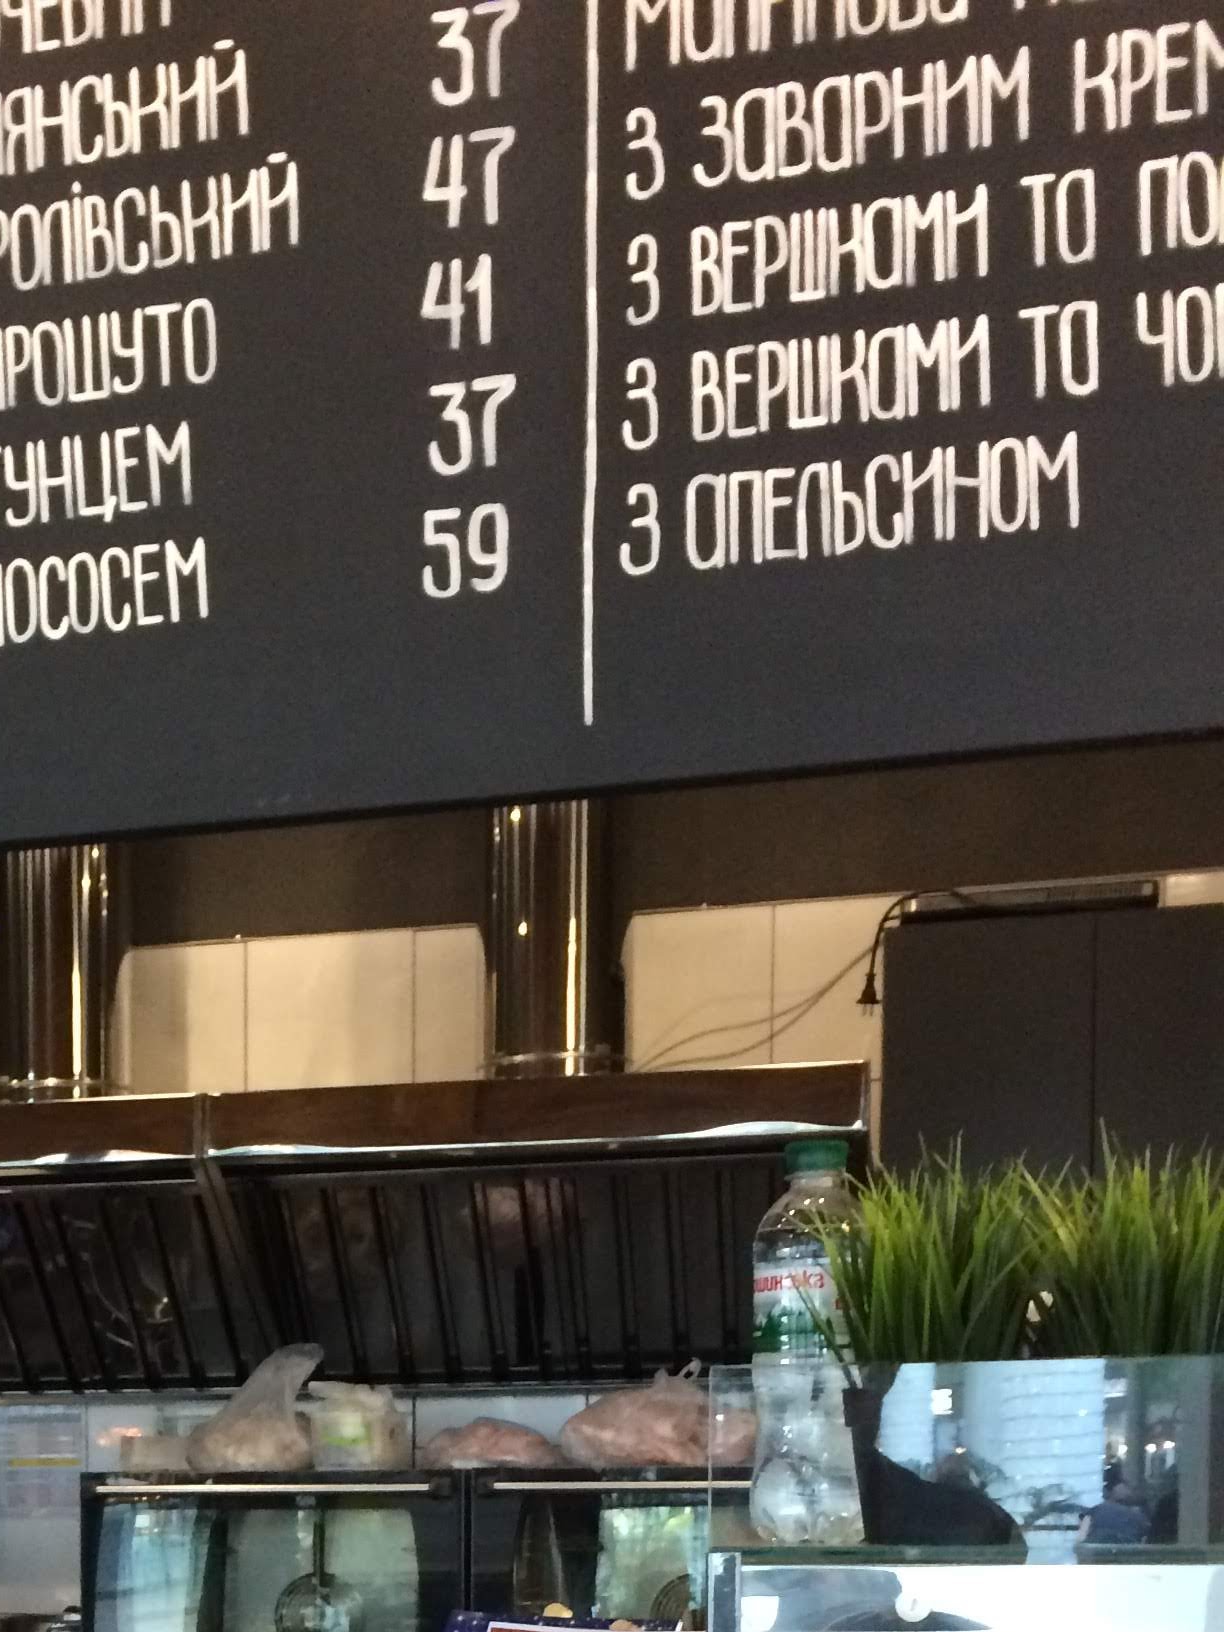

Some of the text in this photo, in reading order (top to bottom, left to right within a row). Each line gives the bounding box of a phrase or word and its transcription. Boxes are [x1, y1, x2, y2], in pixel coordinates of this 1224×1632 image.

[429, 0, 521, 108] 37
[421, 125, 517, 229] 47
[625, 106, 666, 201] З
[691, 45, 1031, 189] ЗАВАРНИМ
[625, 150, 1224, 327] З ВЕРШКАМИ ТА ПО
[419, 253, 493, 350] 41
[621, 282, 1224, 451] З ВЕРШКАМИ ТА ЧО
[427, 373, 517, 477] 37
[421, 502, 510, 599] 59
[618, 430, 1081, 577] З АПЕЛЬСИНОМ
